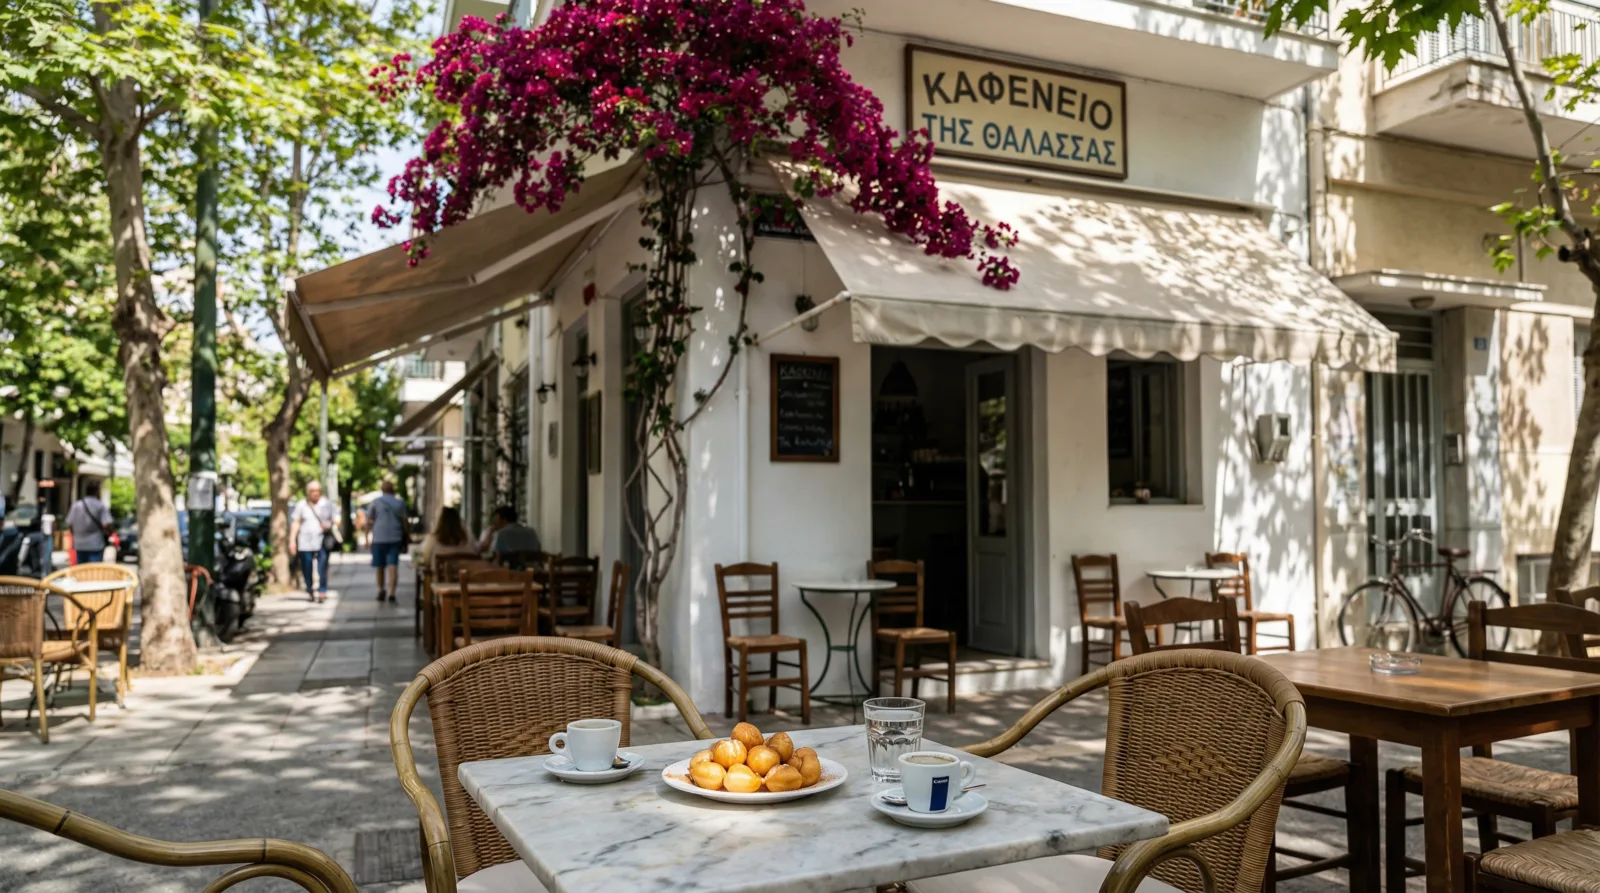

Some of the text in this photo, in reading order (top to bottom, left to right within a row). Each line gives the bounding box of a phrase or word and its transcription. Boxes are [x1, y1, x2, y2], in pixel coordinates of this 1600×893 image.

[923, 71, 1113, 131] ΚΑΦΕΝΕΙΟ
[922, 112, 1116, 166] ΤΗΣ ΘΑΛΑΣΣΑΣ
